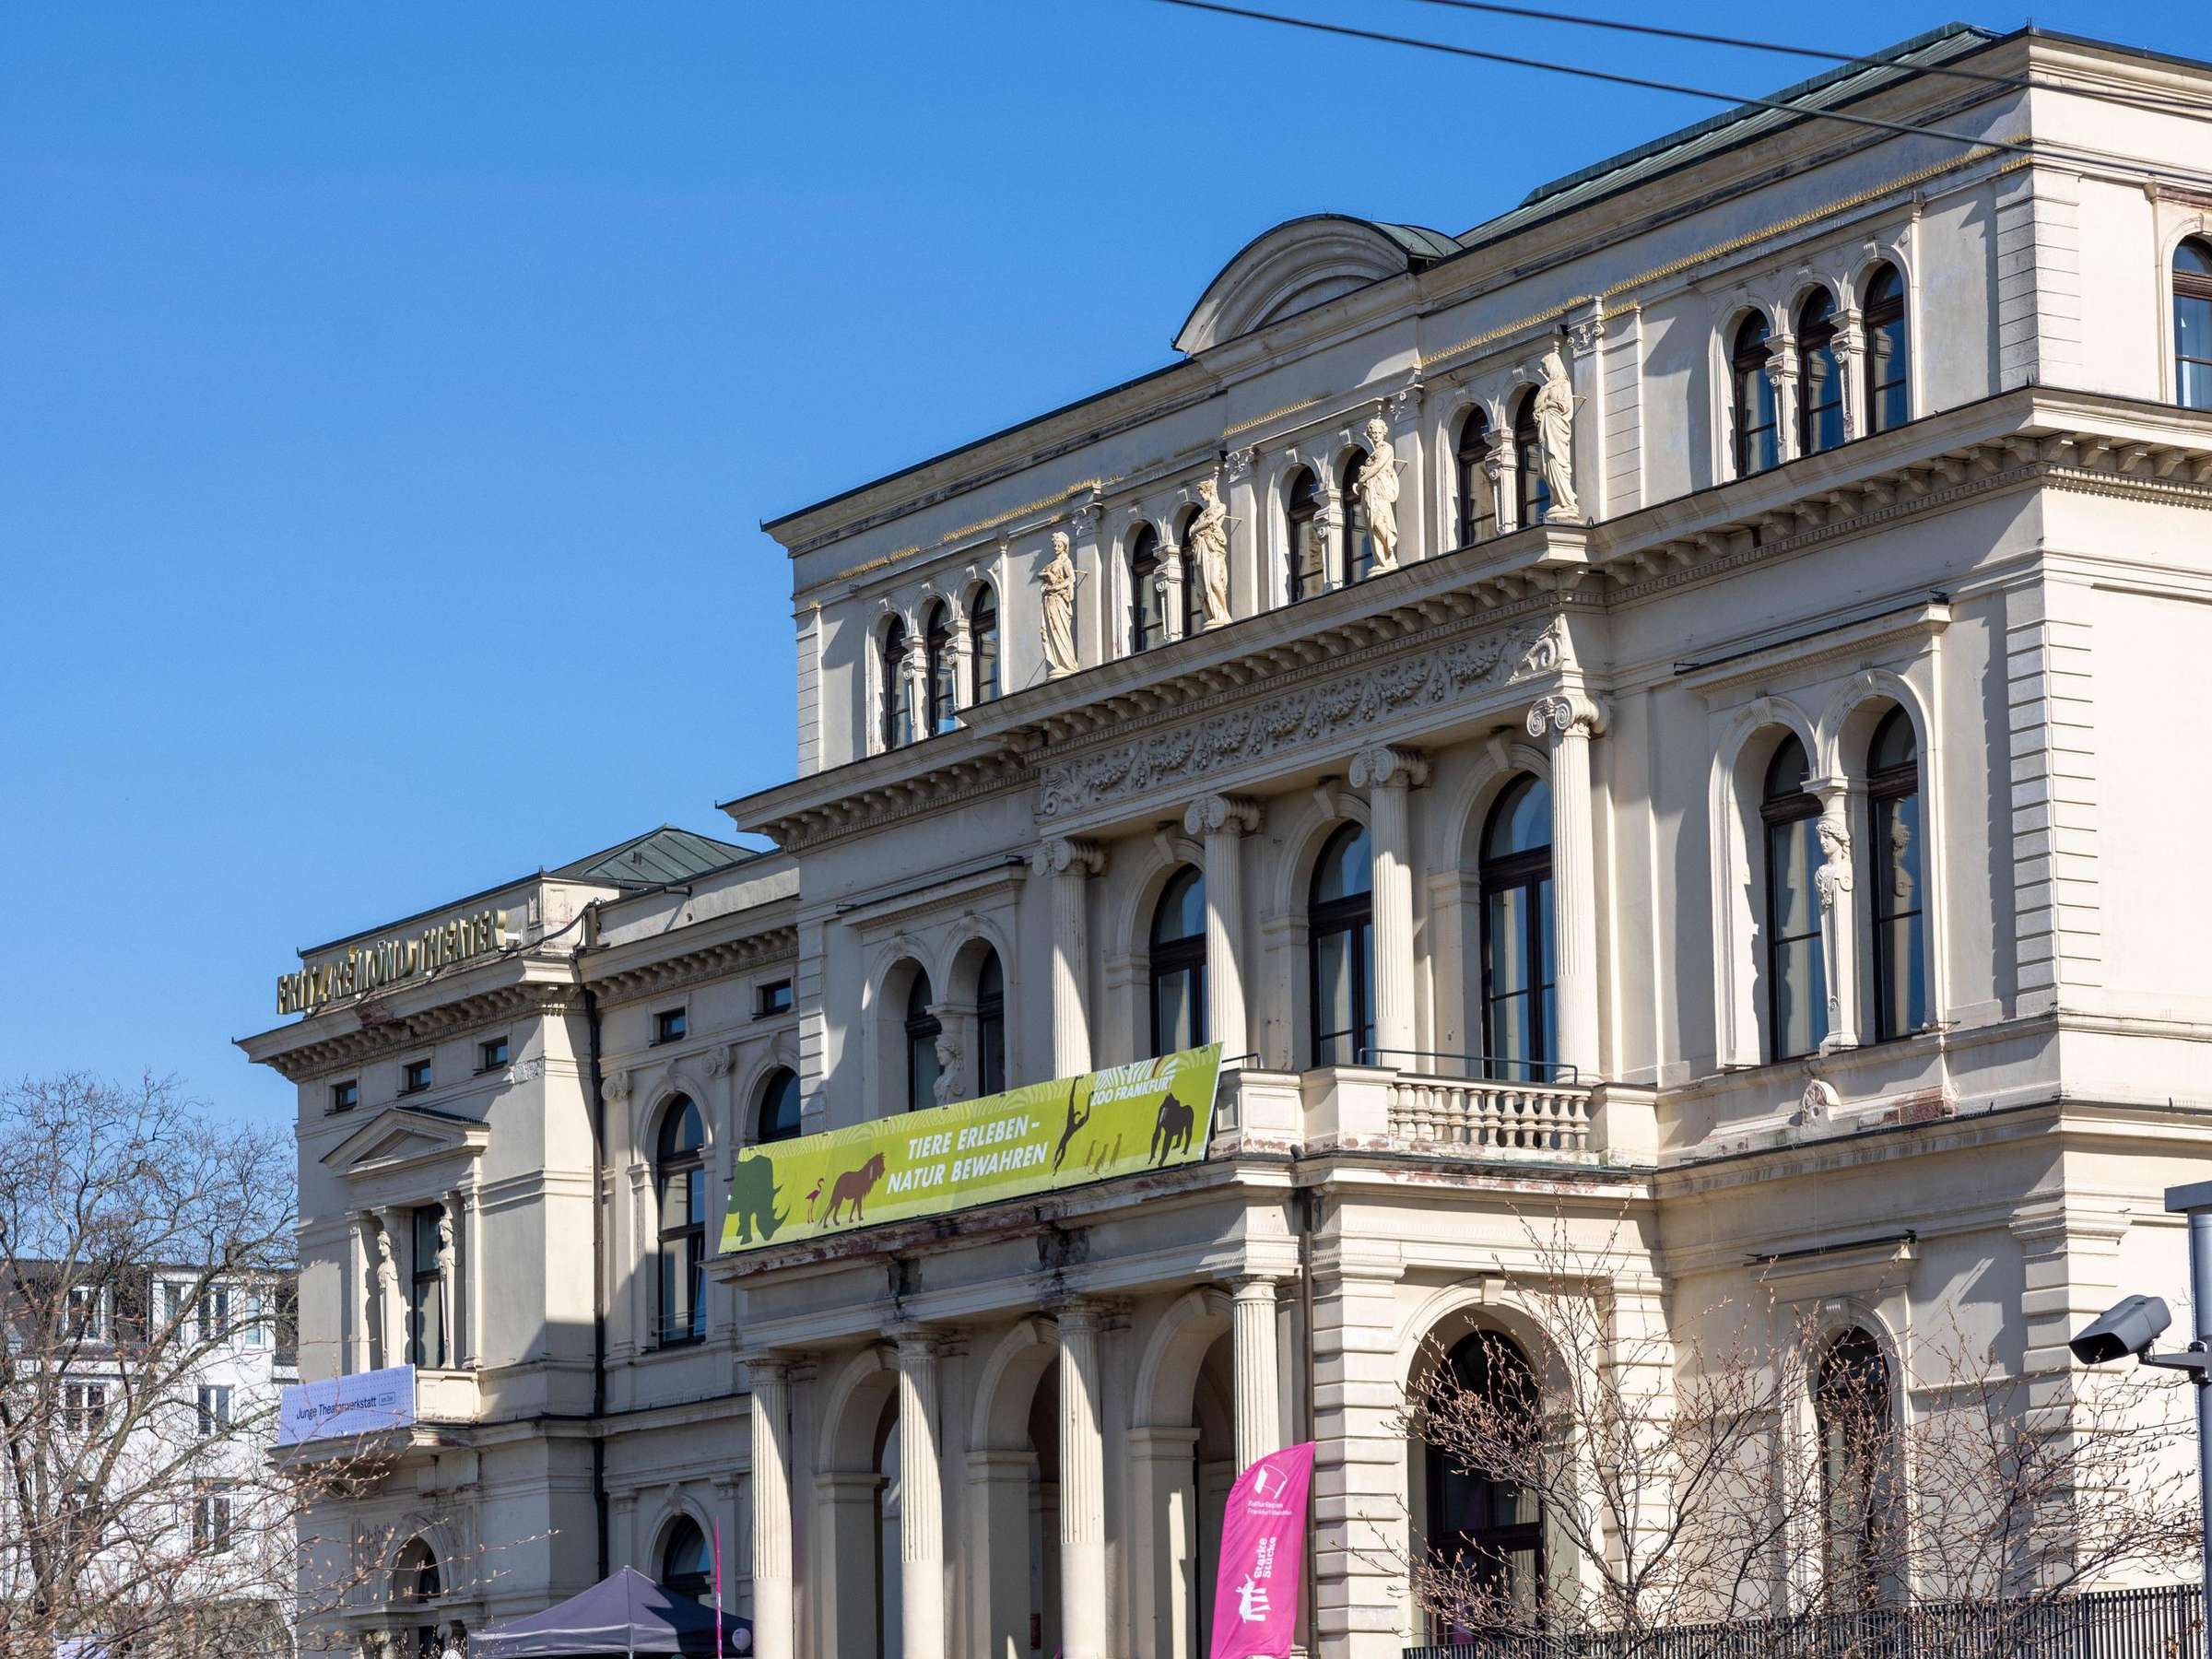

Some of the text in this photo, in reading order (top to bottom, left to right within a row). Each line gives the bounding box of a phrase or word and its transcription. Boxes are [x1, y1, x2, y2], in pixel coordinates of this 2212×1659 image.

[277, 964, 332, 1014] FRITZ
[419, 910, 507, 971] THEATER
[1090, 1076, 1175, 1106] ZOO FRANKFURT
[908, 1131, 953, 1160] TIERE
[957, 1114, 1030, 1151] ERLEBEN
[887, 1142, 1049, 1194] NATUR BEWAHREN
[296, 1406, 317, 1421] Junge
[1253, 1537, 1267, 1578] Starke
